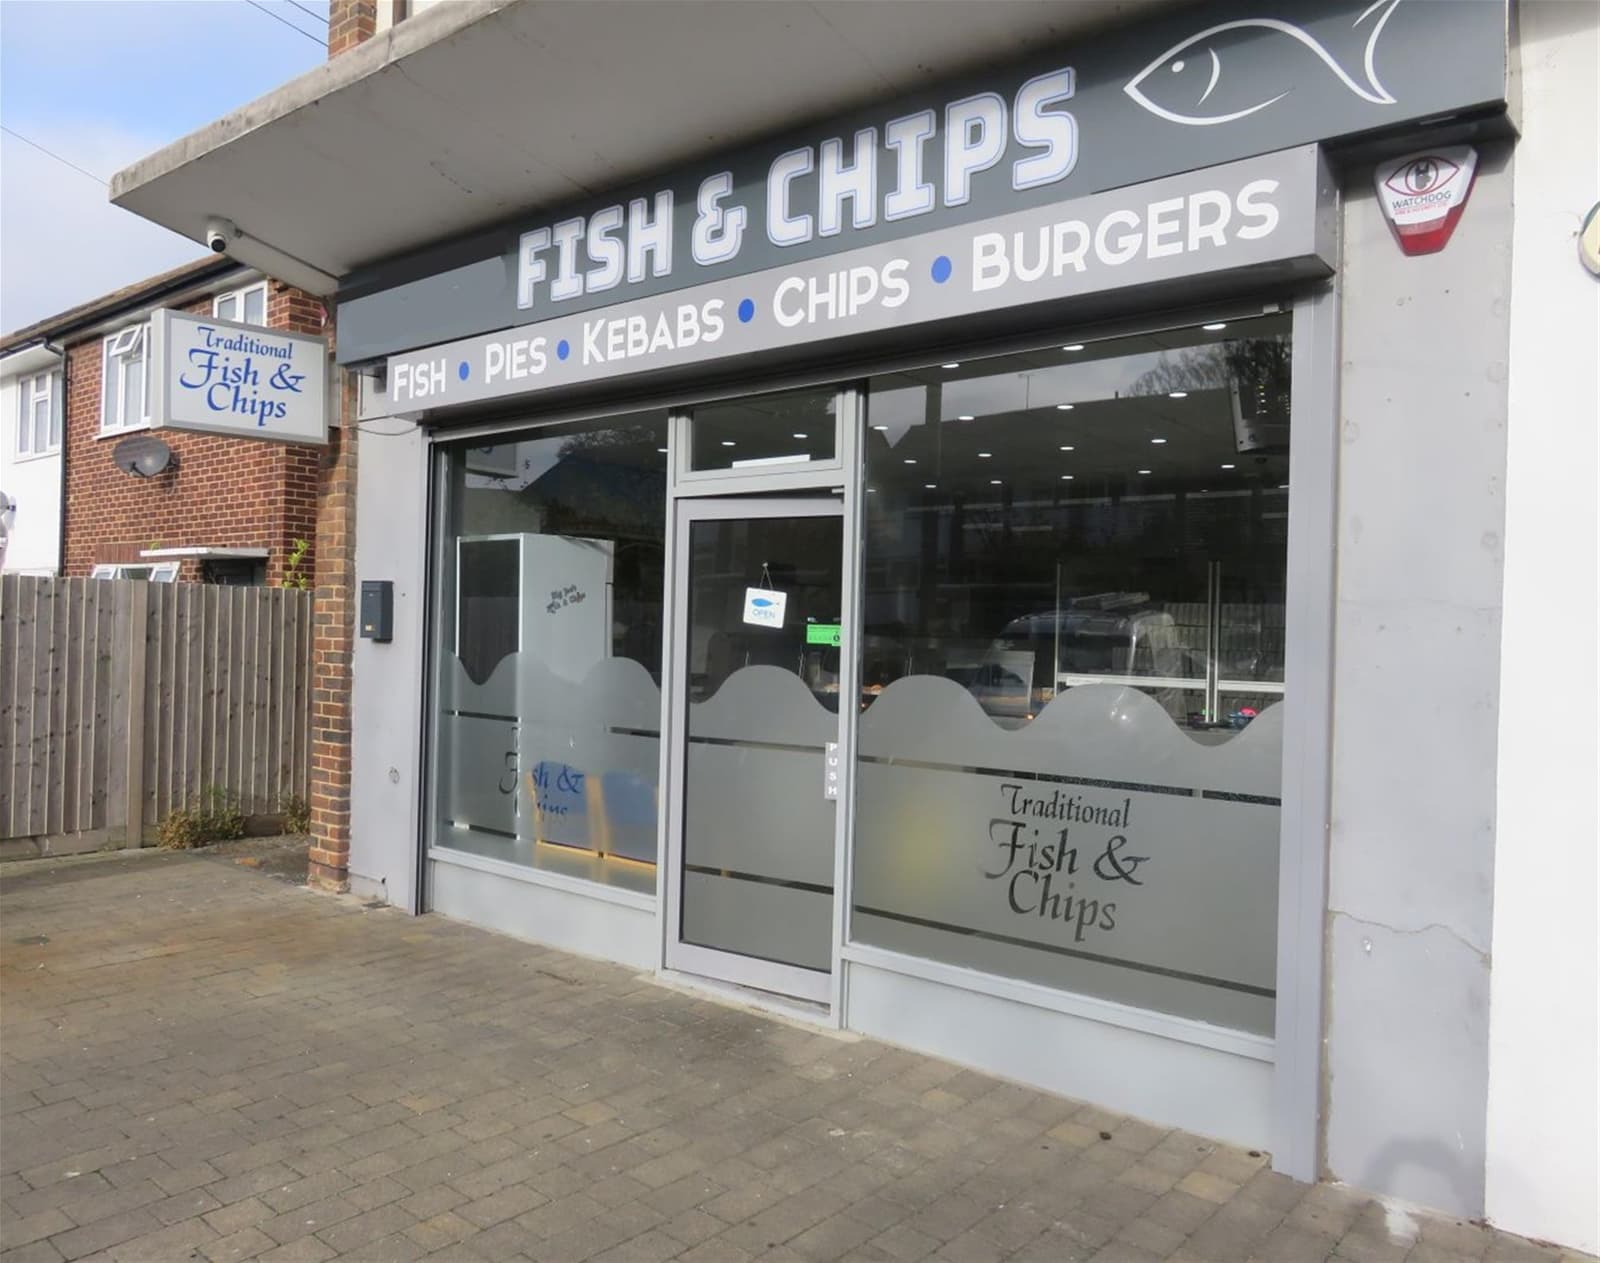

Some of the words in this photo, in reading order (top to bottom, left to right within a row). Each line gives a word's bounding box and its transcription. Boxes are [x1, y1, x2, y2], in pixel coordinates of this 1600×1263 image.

[517, 189, 674, 310] FISH
[691, 170, 748, 266] &
[766, 66, 1079, 247] CHIPS
[1392, 190, 1451, 209] WATCHDOG
[393, 357, 446, 402] FISH
[485, 338, 547, 385] PIES
[582, 300, 725, 366] KEBABS
[773, 258, 910, 328] CHIPS
[972, 179, 1280, 293] BURGERS
[197, 326, 293, 360] Traditional
[180, 348, 259, 389] Fish
[269, 363, 306, 393] &
[207, 382, 286, 427] Chips
[752, 608, 776, 619] OPEN
[828, 743, 838, 796] PUSH
[1000, 784, 1132, 828] Traditional
[983, 818, 1080, 880] Fish
[1093, 835, 1151, 886] &
[1008, 869, 1117, 942] Chips
